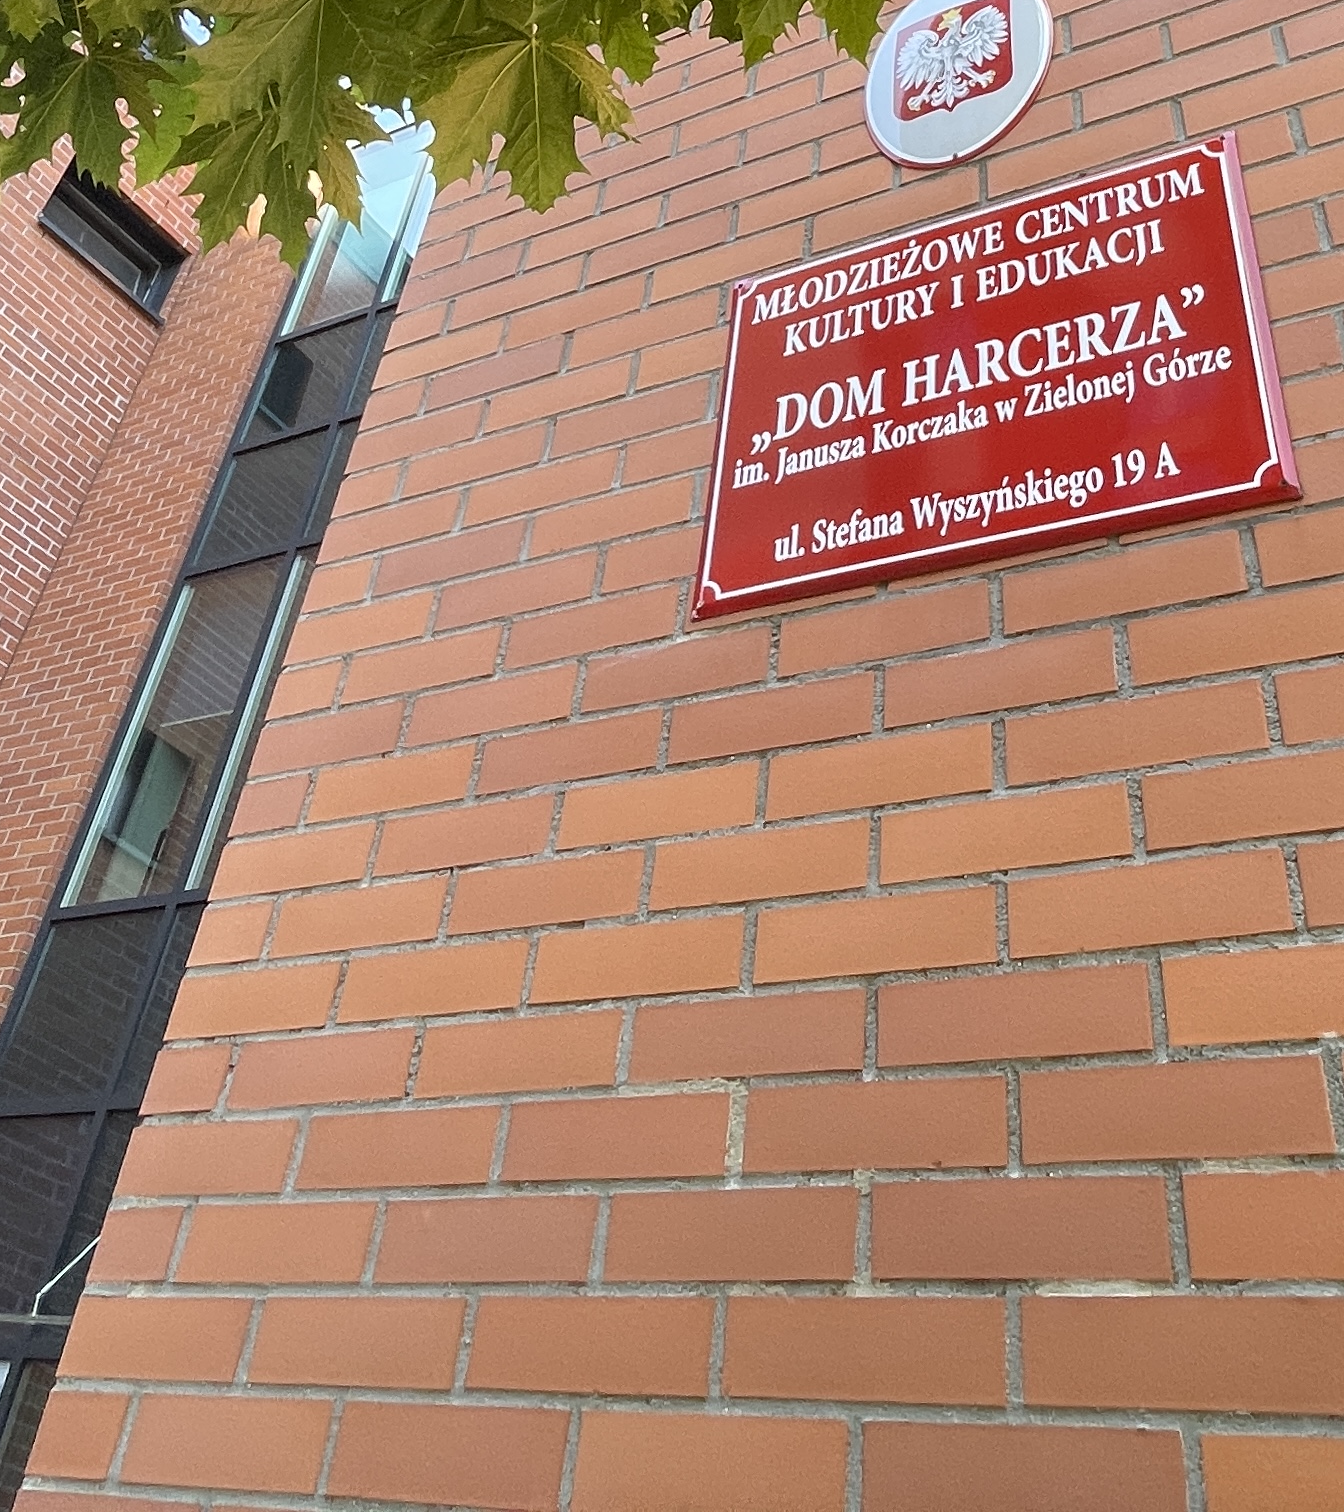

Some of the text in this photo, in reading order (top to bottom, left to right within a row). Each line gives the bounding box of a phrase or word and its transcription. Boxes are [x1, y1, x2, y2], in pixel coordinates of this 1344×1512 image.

[752, 162, 1205, 325] MŁODZIEŻOWE CENTRUM
[782, 219, 1165, 356] KULTURY I EDUKACJI
[731, 346, 1233, 490] im. Janusza Korczaka w Zielonej Górze
[749, 283, 1205, 456] „DOM HARCERZA”
[774, 441, 1182, 562] ul. Stefana Wyszyńskiego 19 A
